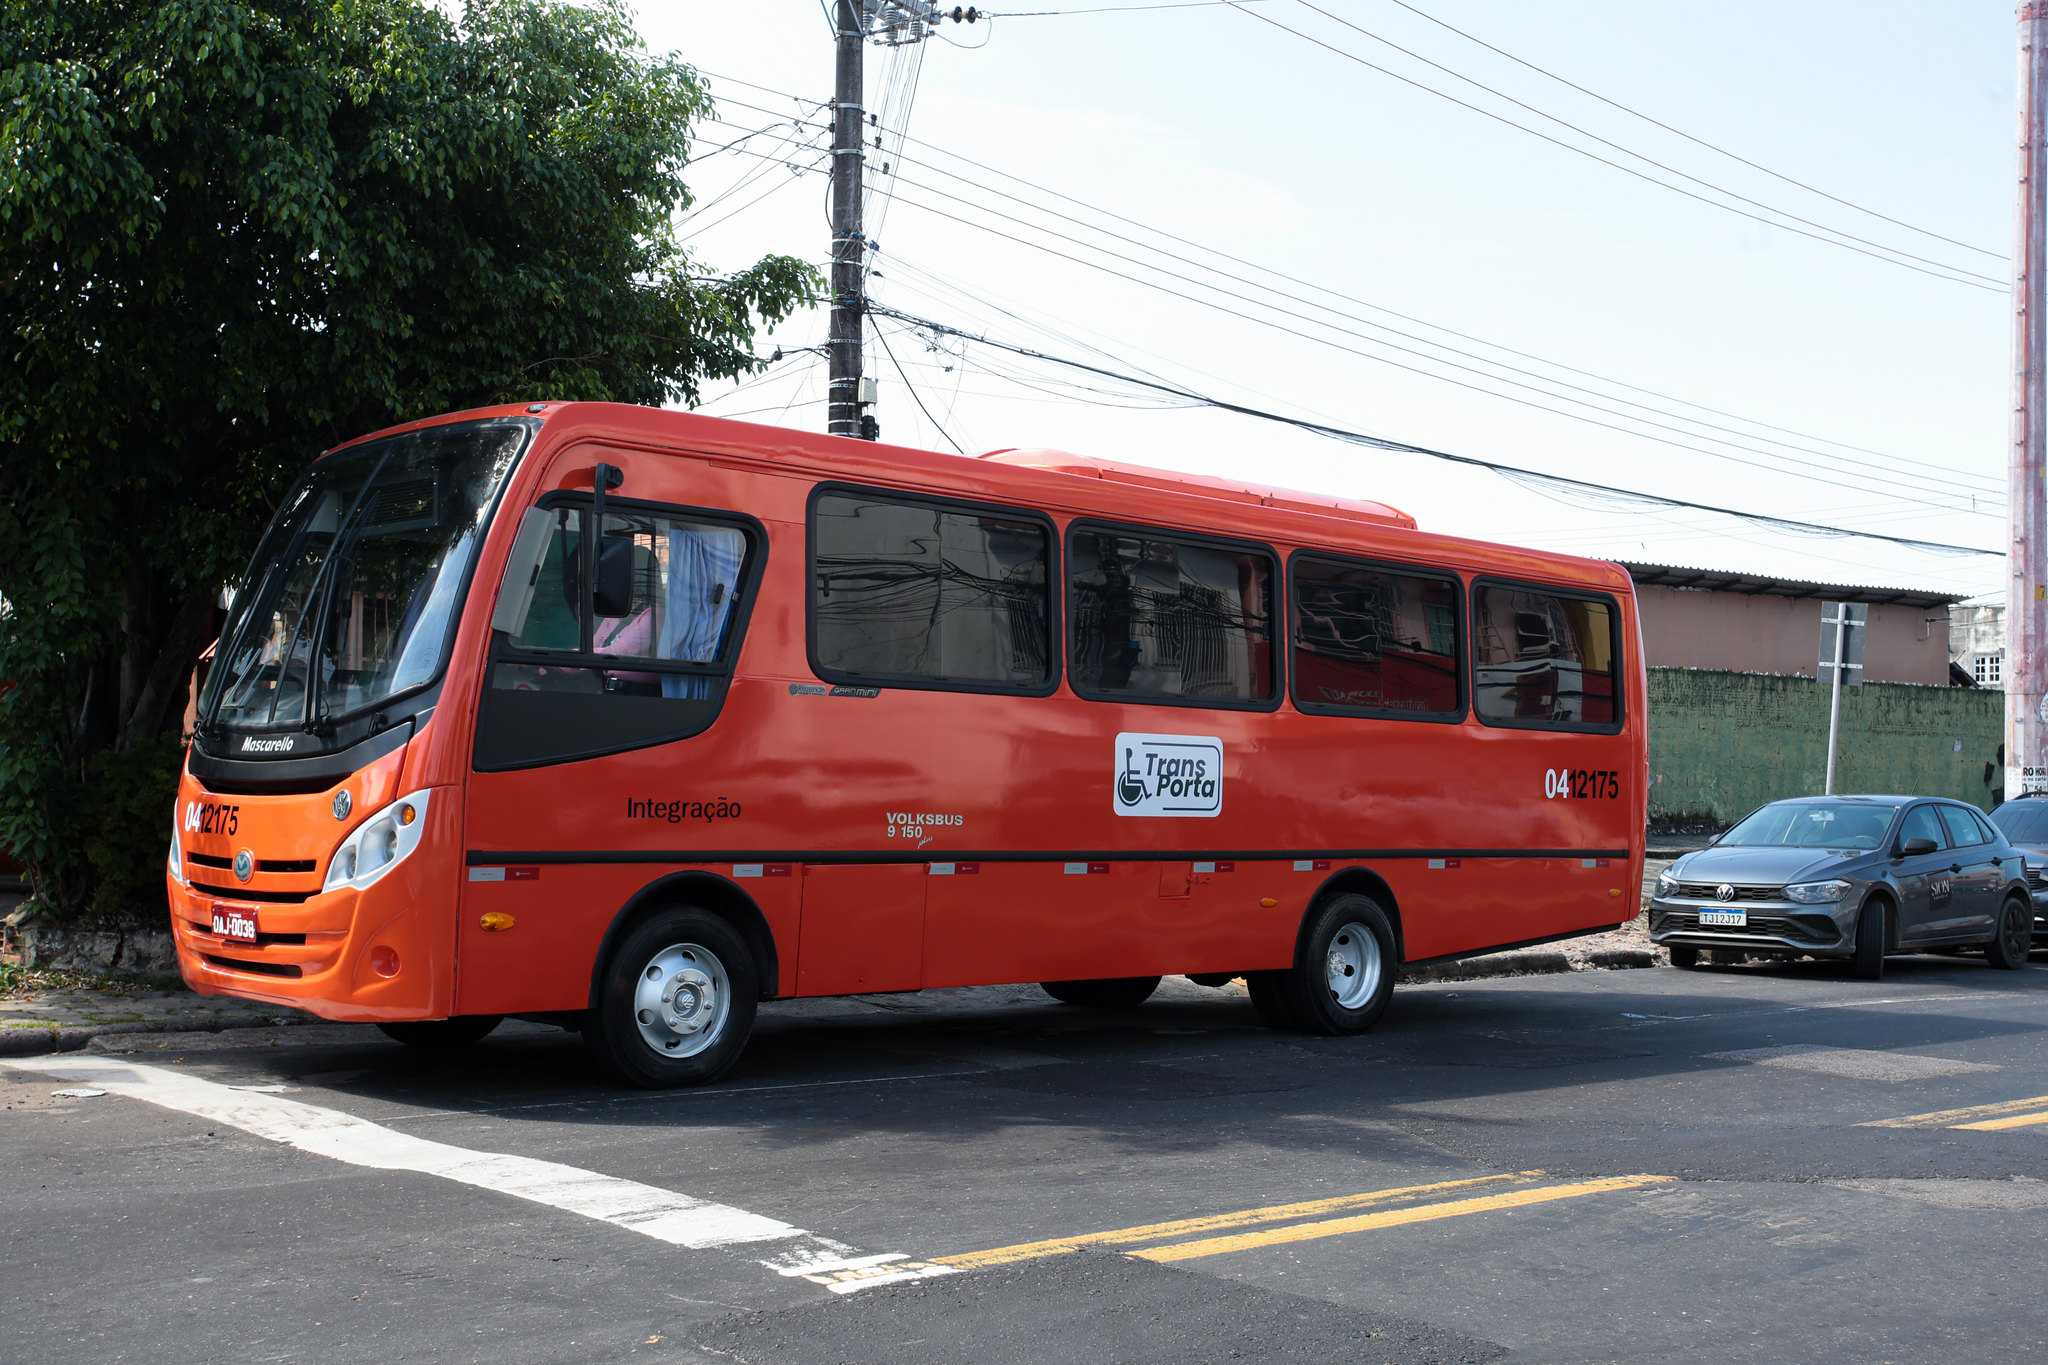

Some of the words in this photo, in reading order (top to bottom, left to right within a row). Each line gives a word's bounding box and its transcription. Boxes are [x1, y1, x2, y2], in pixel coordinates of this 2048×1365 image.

[241, 735, 294, 752] Mascarello
[1145, 753, 1206, 778] Trans
[1156, 773, 1215, 798] Porta
[1545, 768, 1619, 799] 0412175
[185, 801, 239, 836] 0412175
[627, 797, 742, 823] Integração
[886, 812, 964, 826] VOLKSBUS
[887, 825, 896, 837] 9
[901, 825, 923, 838] 150
